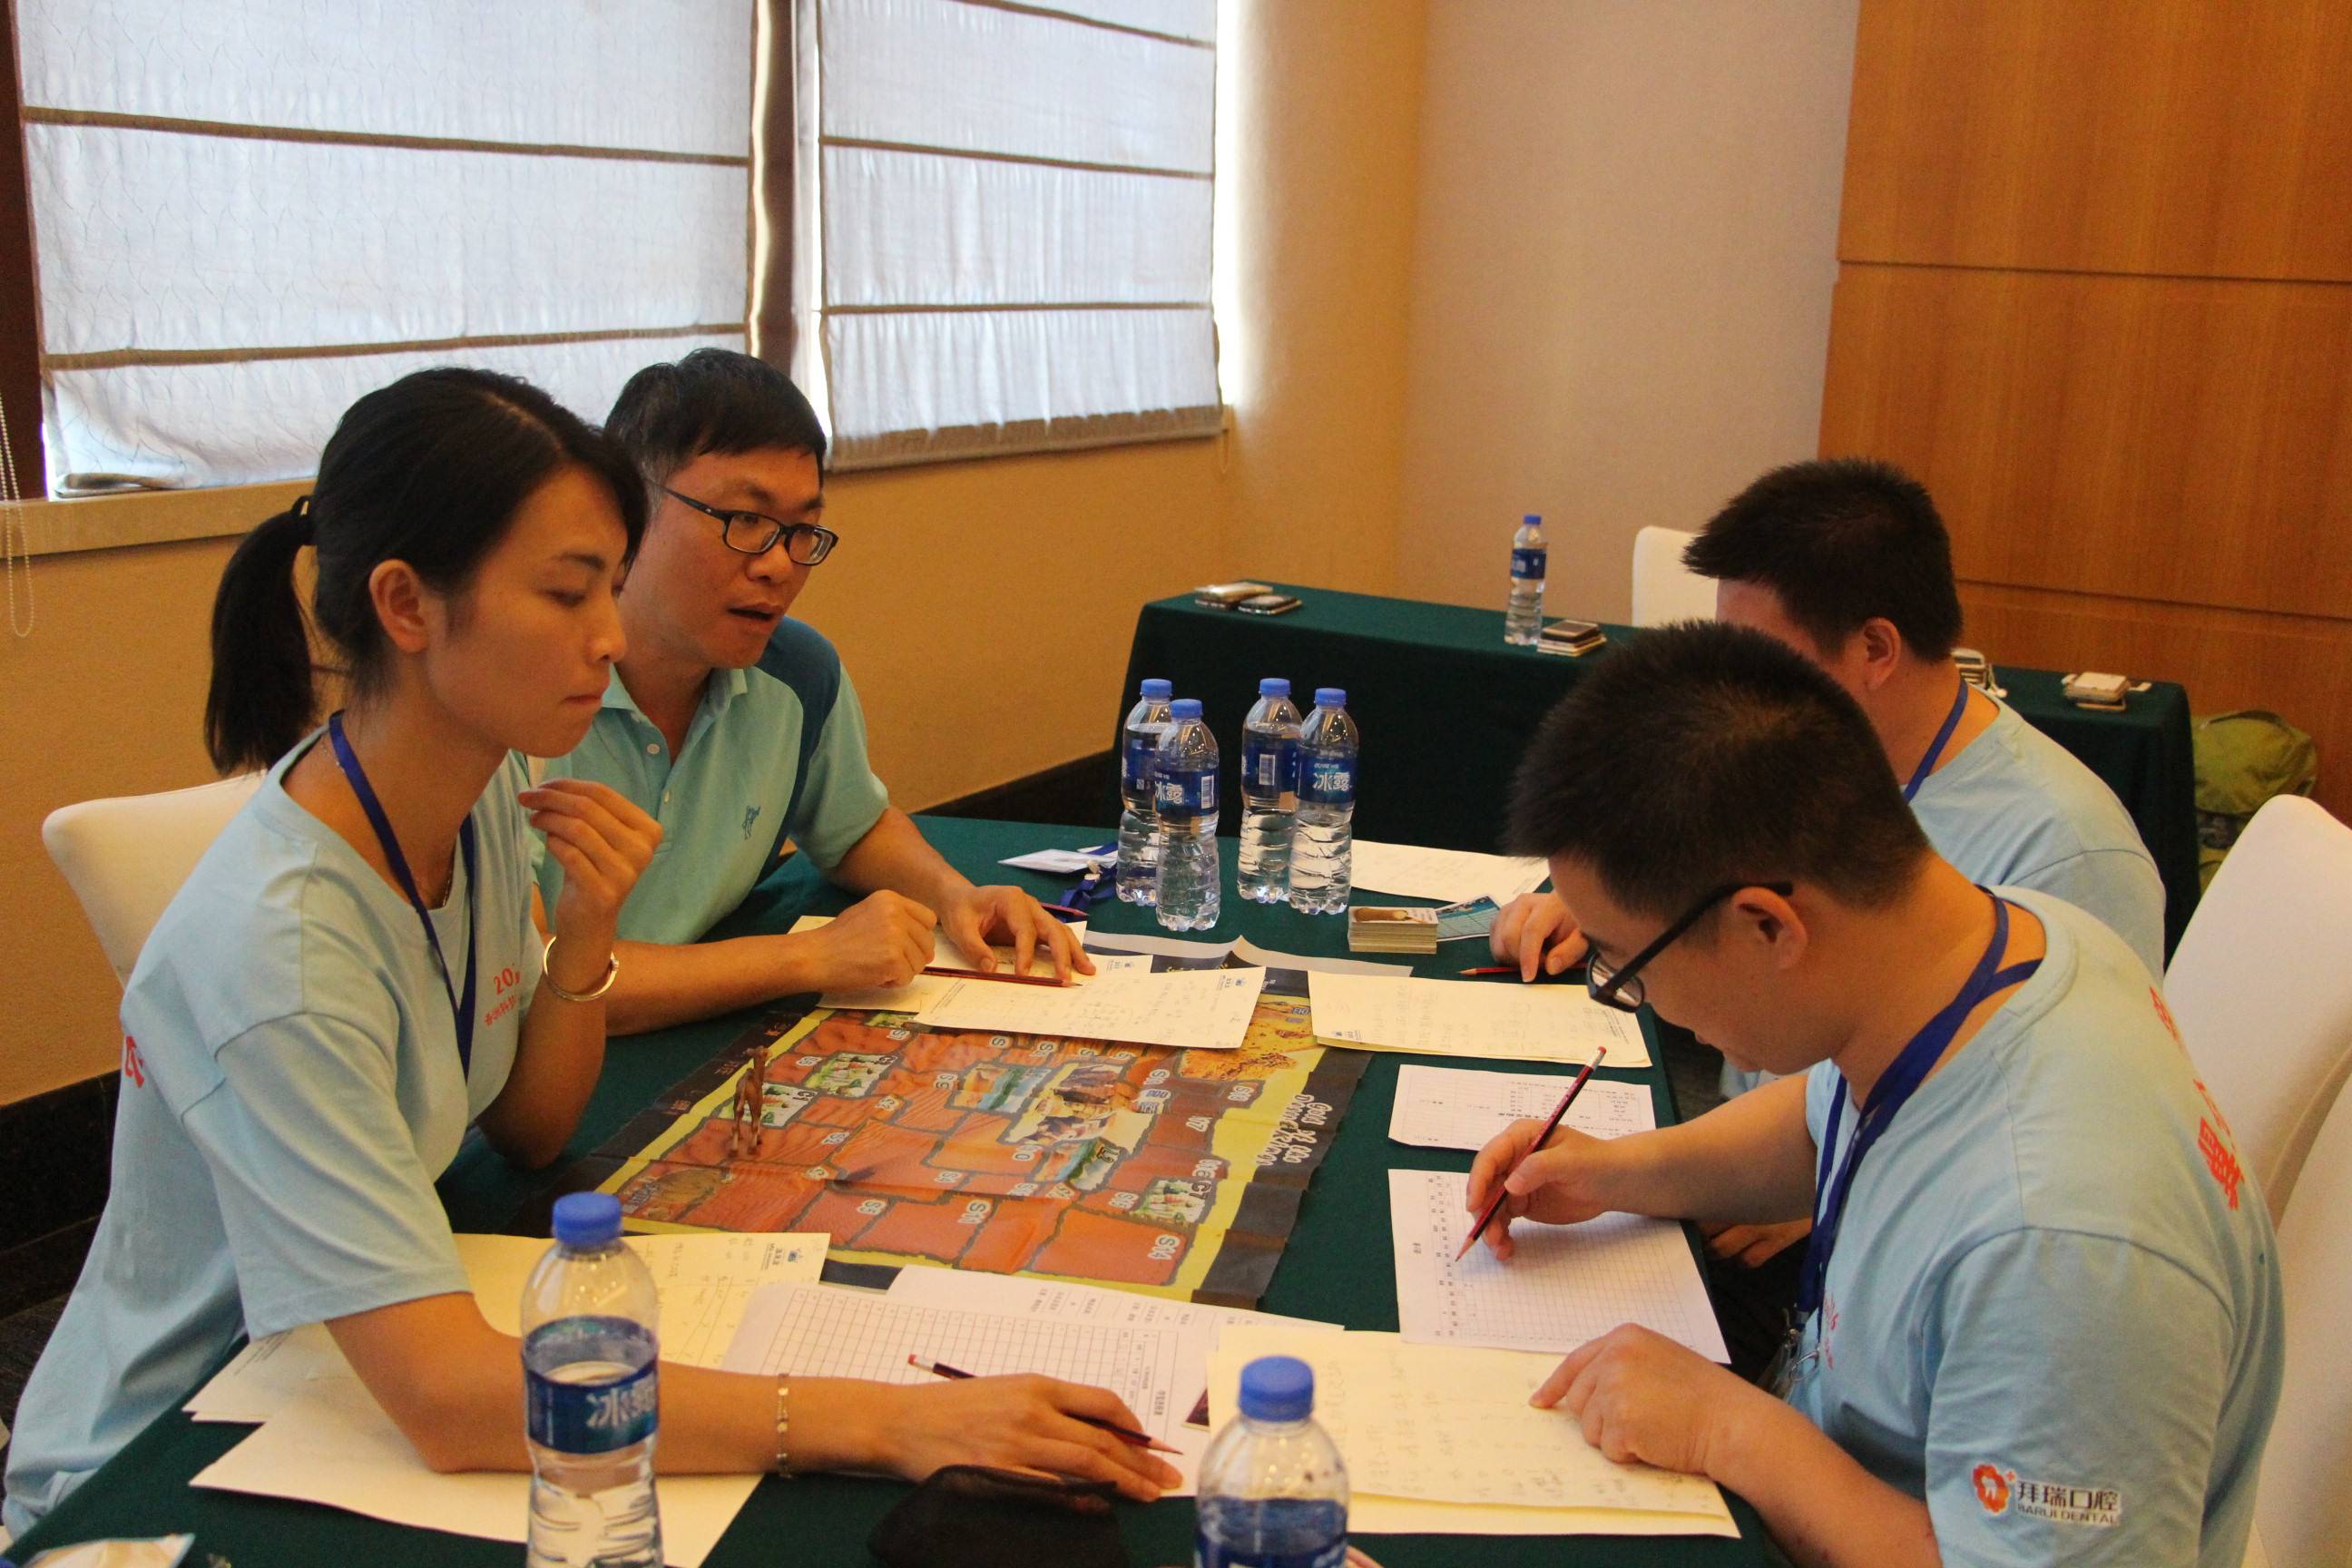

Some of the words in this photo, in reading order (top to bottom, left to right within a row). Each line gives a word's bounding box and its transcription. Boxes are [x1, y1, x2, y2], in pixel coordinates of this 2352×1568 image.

[1312, 771, 1351, 792] 冰露
[1255, 1127, 1293, 1166] Kings
[1189, 1181, 1211, 1200] C7
[1147, 1235, 1181, 1260] S14
[2017, 1481, 2120, 1511] 拜瑞口腔
[2061, 1510, 2119, 1525] DENTAL
